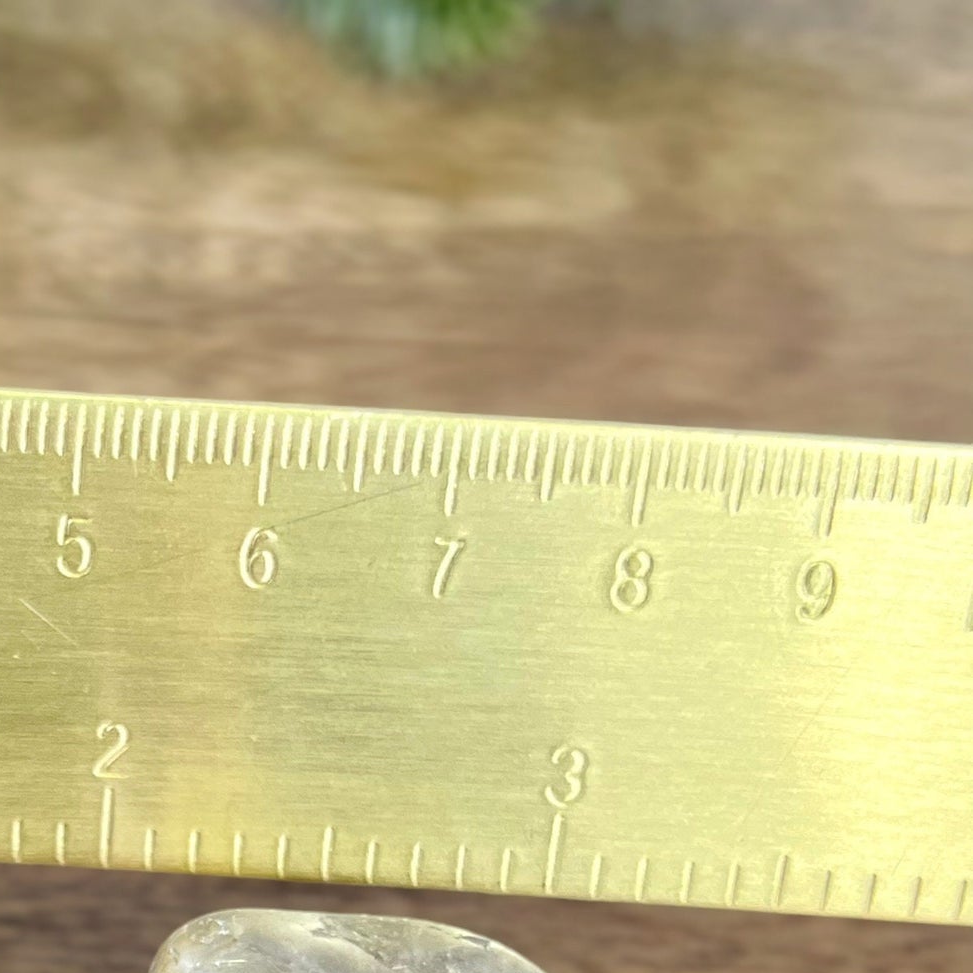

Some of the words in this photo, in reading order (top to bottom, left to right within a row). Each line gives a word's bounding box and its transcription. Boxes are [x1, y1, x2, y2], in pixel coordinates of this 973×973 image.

[56, 513, 94, 579] 5
[238, 526, 279, 590] 6
[432, 533, 465, 599] 7
[609, 545, 655, 614] 8
[796, 560, 836, 623] 9
[92, 720, 131, 780] 2
[545, 745, 589, 809] 3
